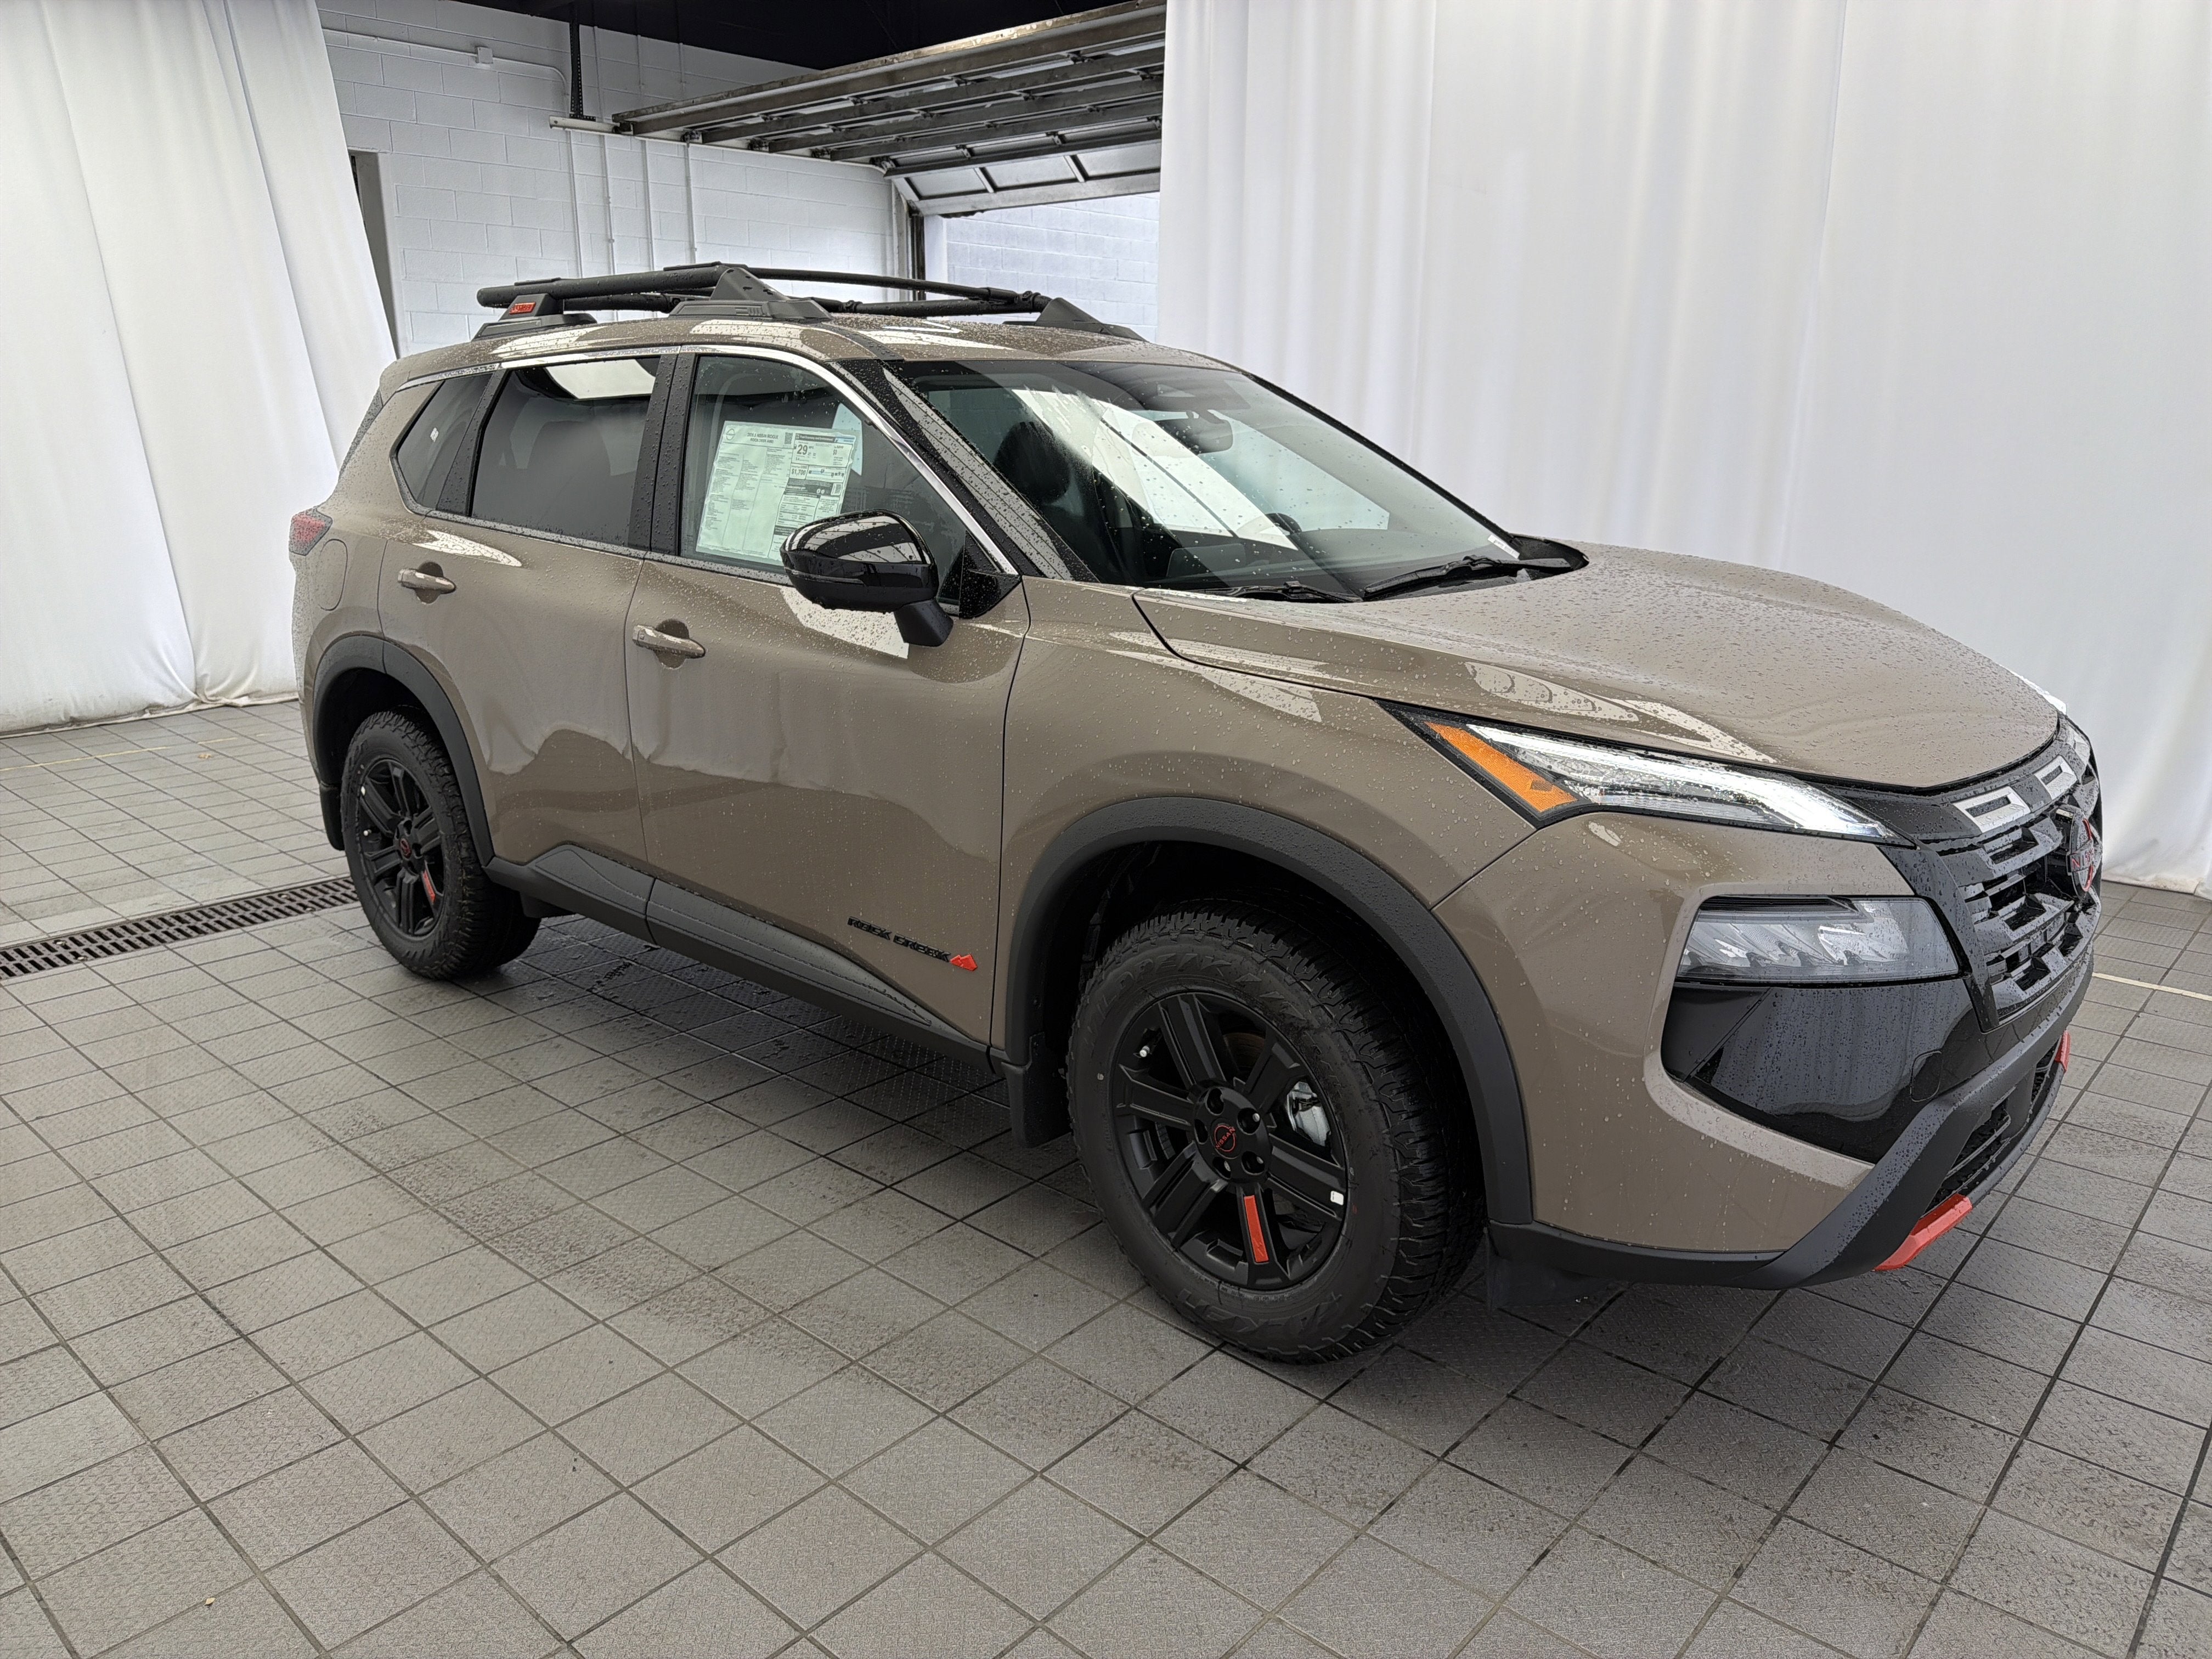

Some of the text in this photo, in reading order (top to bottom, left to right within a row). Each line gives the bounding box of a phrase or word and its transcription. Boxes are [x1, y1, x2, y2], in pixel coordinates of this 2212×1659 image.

[797, 444, 808, 455] 29
[847, 916, 951, 963] ROCK CREEK
[1216, 1126, 1235, 1149] NISSAN
